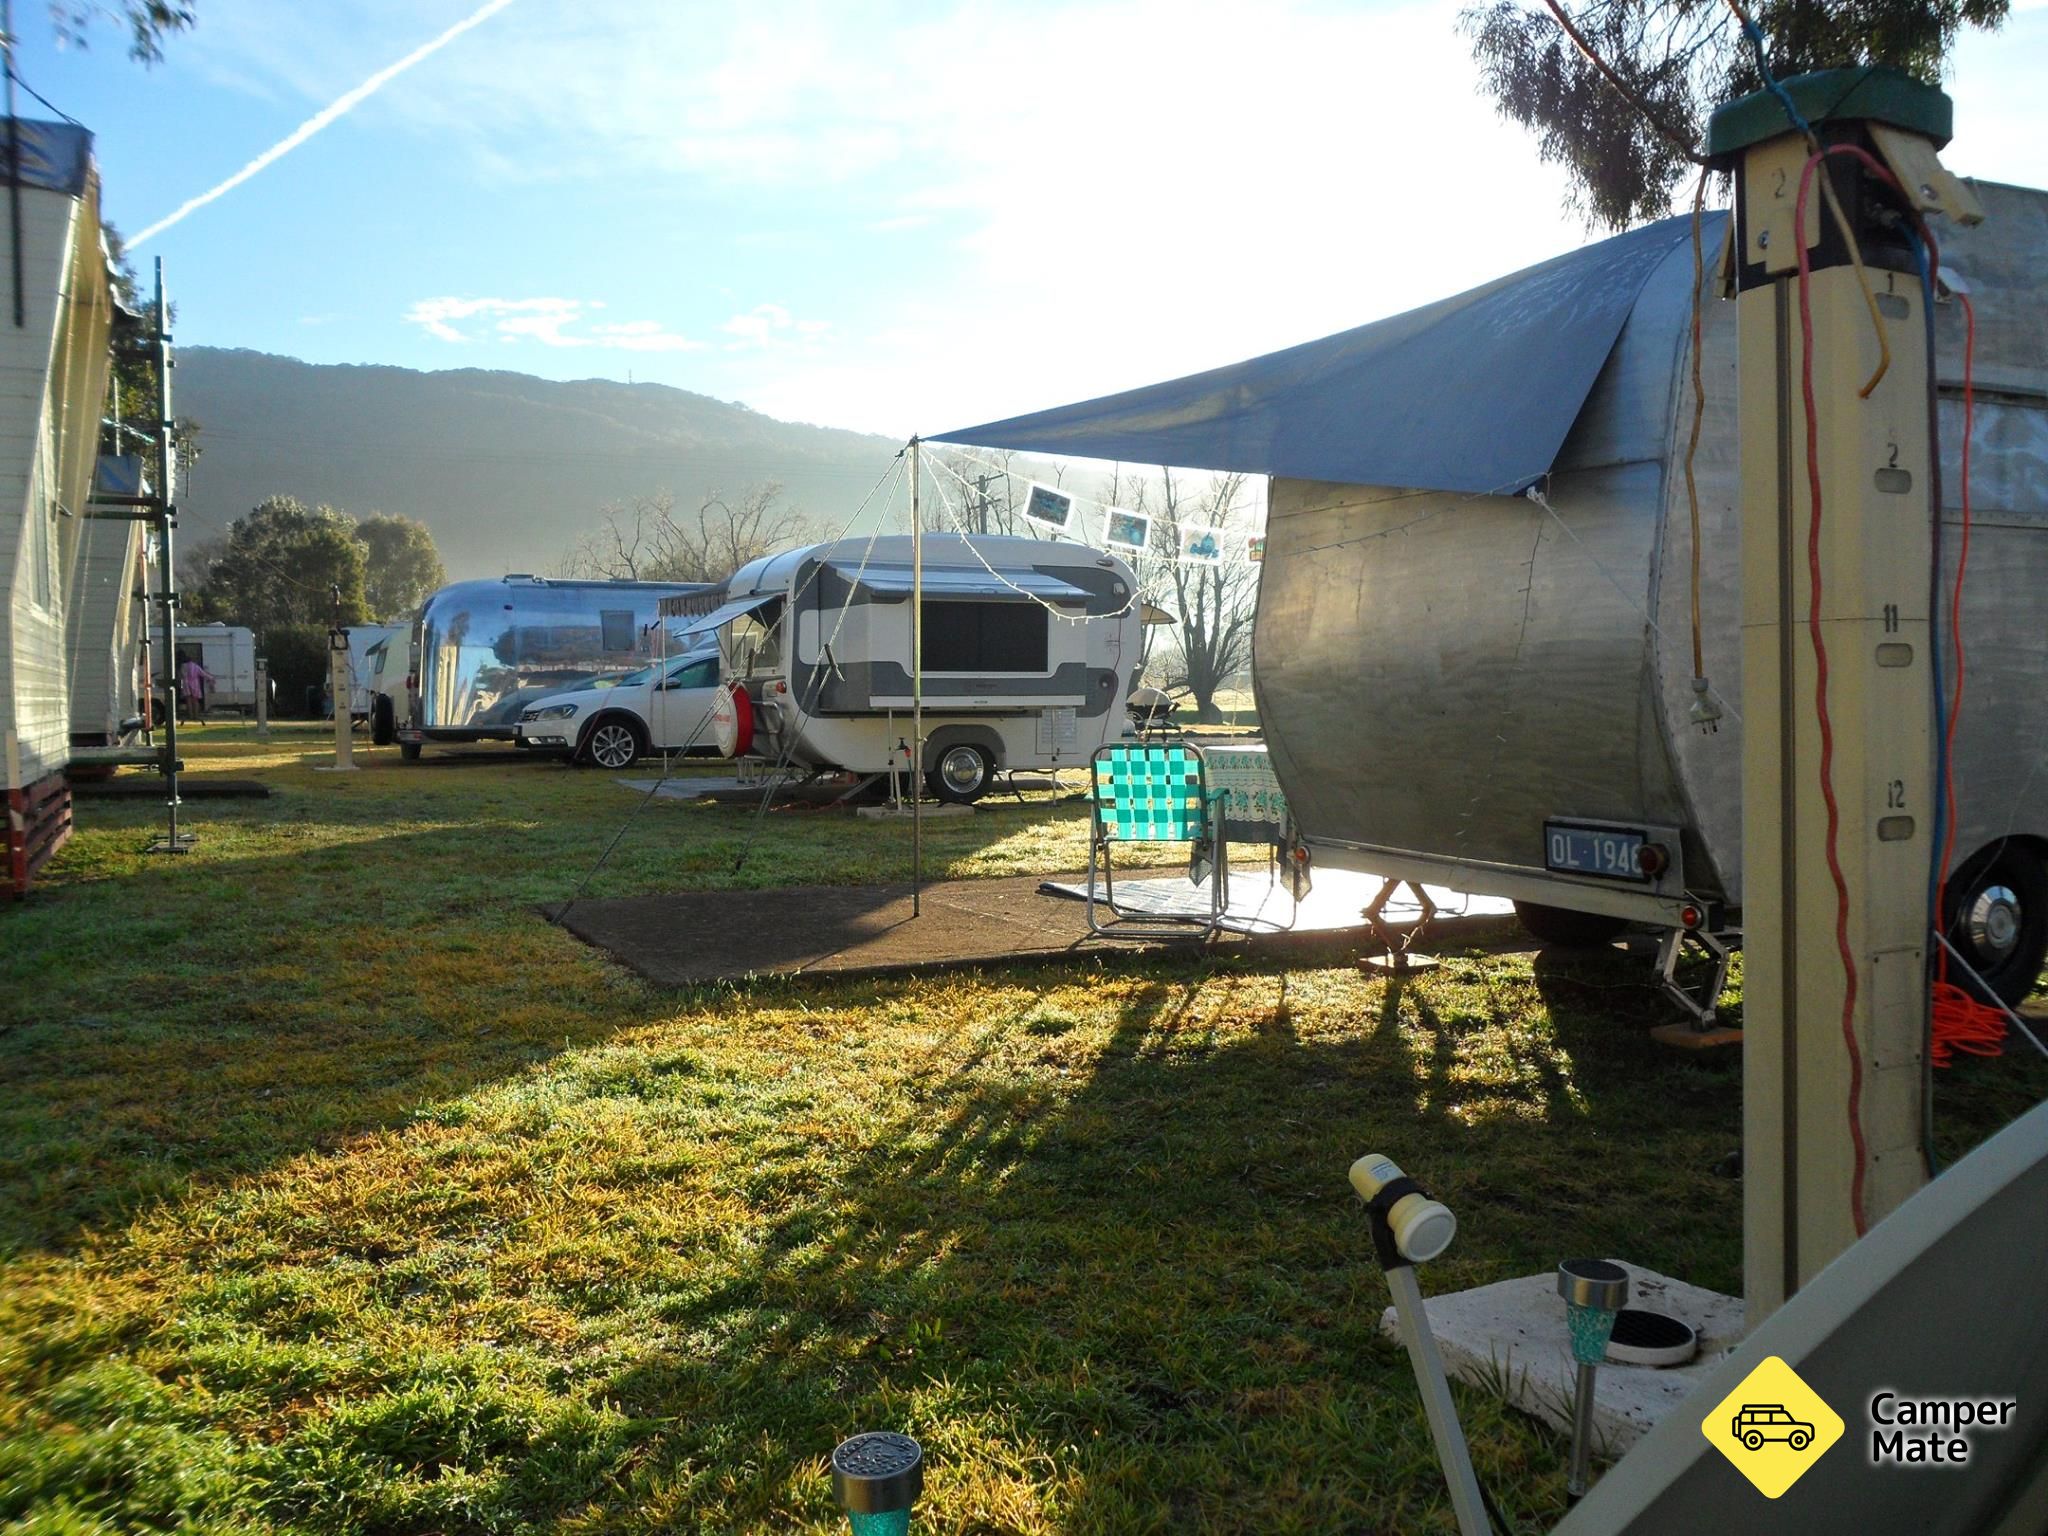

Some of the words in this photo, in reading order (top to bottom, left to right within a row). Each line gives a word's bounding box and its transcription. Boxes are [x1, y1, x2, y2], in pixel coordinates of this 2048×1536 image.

[1771, 167, 1786, 199] 2
[1887, 272, 1894, 292] 1
[1888, 442, 1898, 467] 2
[1883, 604, 1898, 632] 11
[1888, 780, 1905, 808] 12
